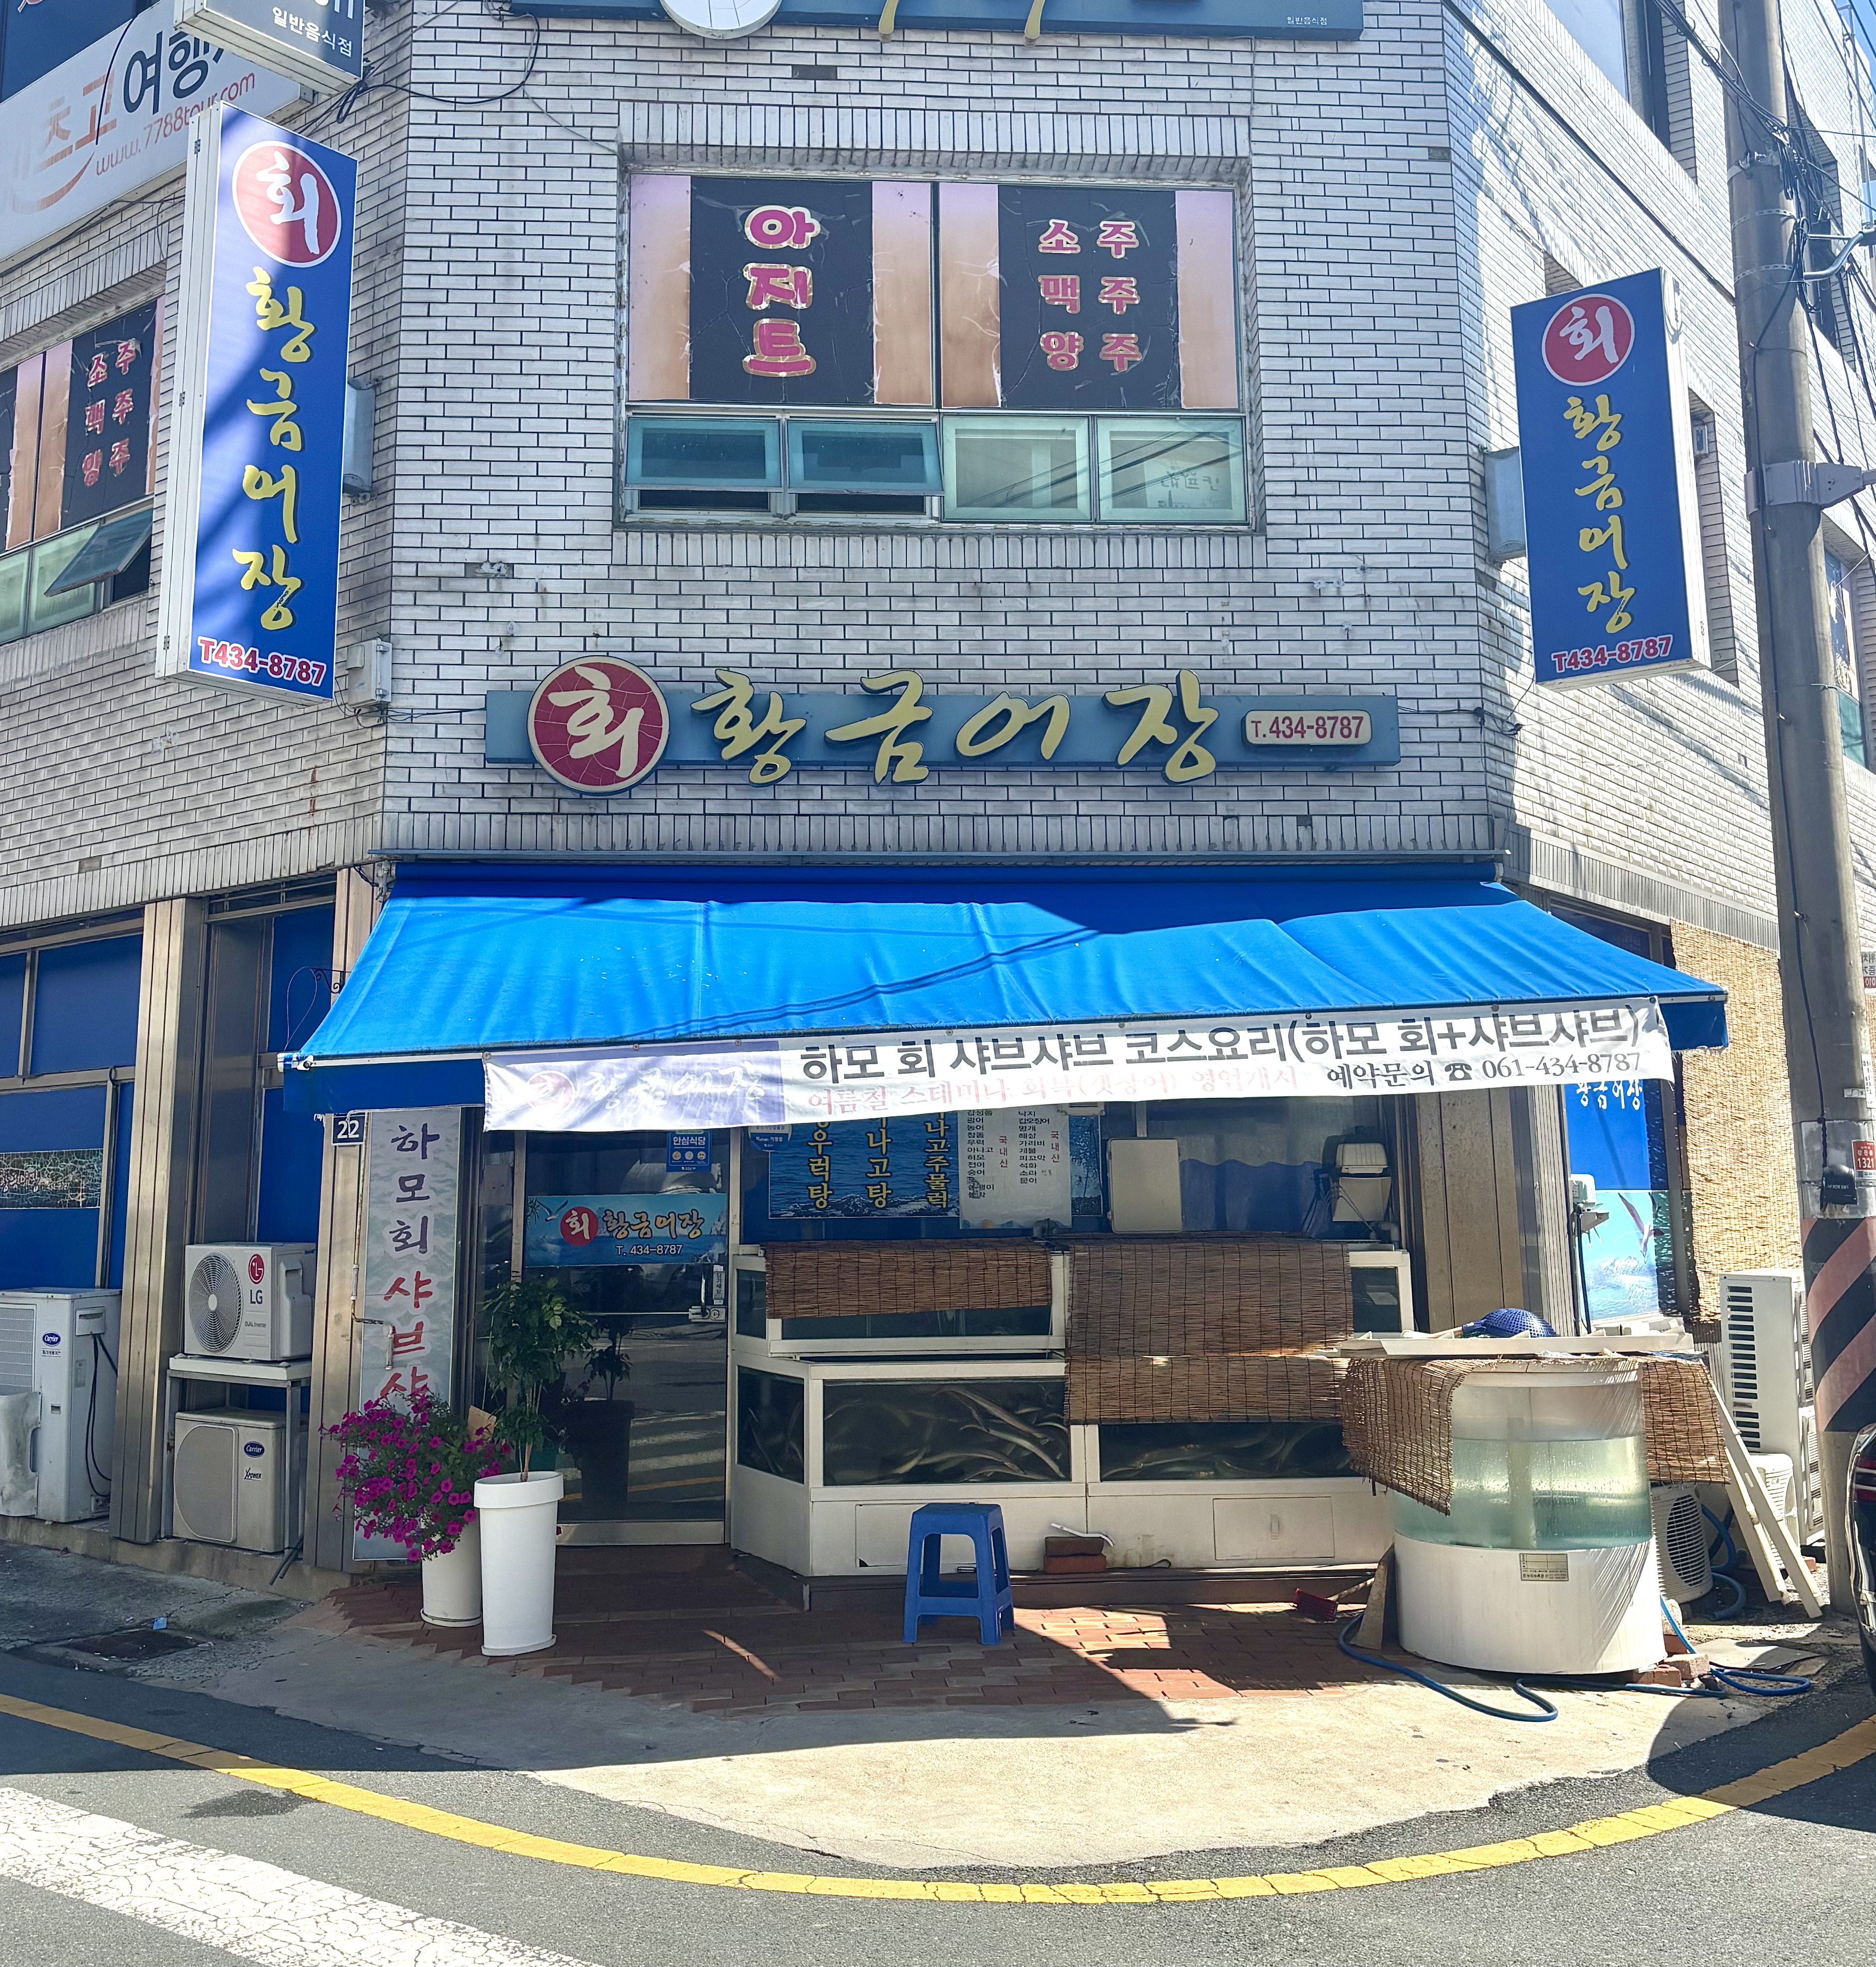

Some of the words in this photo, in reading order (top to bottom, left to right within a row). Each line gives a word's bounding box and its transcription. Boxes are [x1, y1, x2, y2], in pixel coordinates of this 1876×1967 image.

[272, 7, 352, 57] 일반음식점
[1287, 16, 1327, 25] 일반음식점
[256, 151, 320, 255] 회
[1037, 219, 1139, 260] 소주
[743, 205, 820, 378] 아지트
[1038, 274, 1140, 315] 맥주
[1040, 331, 1142, 372] 양주
[1559, 305, 1620, 365] 회
[88, 341, 136, 388] 소주
[85, 388, 134, 434] 맥주
[82, 438, 130, 487] 양주
[232, 265, 317, 632] 황금어장
[1562, 394, 1636, 634] 황금어장
[198, 636, 328, 688] T434-8787
[1551, 633, 1674, 674] T434-8787
[548, 665, 644, 778] 회
[690, 668, 1220, 787] 황금어장
[800, 1044, 885, 1084] 하모
[897, 1039, 936, 1078] 회
[950, 1033, 1114, 1075] 샤브샤브
[1125, 1019, 1387, 1064] 코스요리(하모
[1397, 1004, 1639, 1056] 회+샤브샤브)
[582, 1061, 766, 1110] 황금어장
[1327, 1060, 1435, 1090] 예약문의
[1482, 1051, 1641, 1079] 061-434-8787
[808, 1085, 887, 1115] 여름철
[900, 1078, 1009, 1105] 스테미나
[336, 1119, 360, 1140] 22
[672, 1136, 706, 1146] 안심식당
[1050, 1131, 1060, 1163] 국내산
[999, 1135, 1008, 1168] 국내산
[1857, 1157, 1874, 1169] 1321
[565, 1210, 590, 1240] 회
[603, 1208, 705, 1240] 황금어장
[616, 1245, 626, 1255] T.
[630, 1244, 683, 1255] 434-8787
[250, 1289, 263, 1305] LG
[246, 1444, 263, 1453] Carrier
